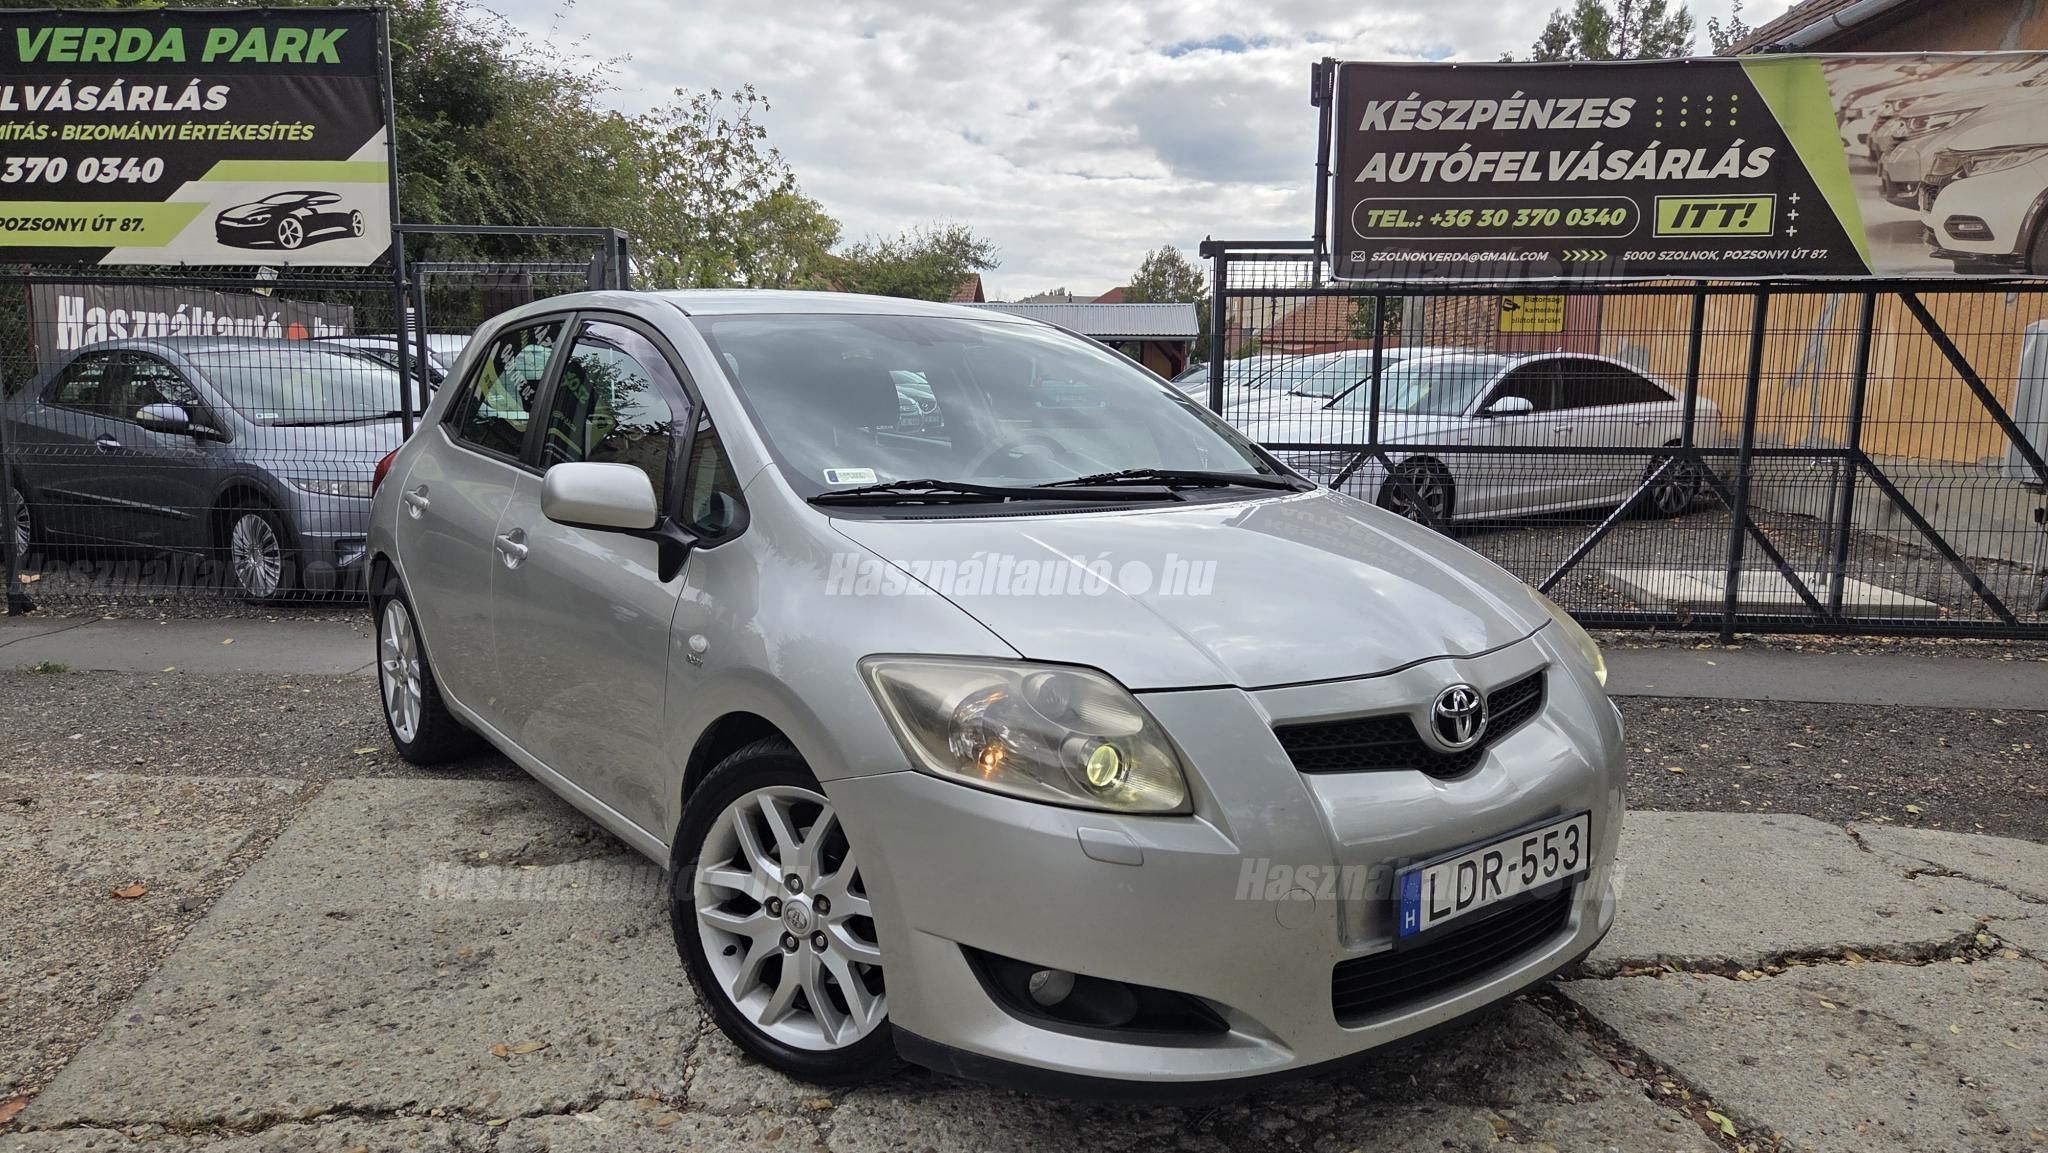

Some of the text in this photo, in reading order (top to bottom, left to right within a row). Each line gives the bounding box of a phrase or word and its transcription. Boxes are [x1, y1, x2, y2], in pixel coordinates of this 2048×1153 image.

[16, 27, 349, 64] VERDA PARK
[0, 78, 230, 111] LVÁSÁRLÁS
[1358, 90, 1636, 131] KÉSZPÉNZES
[61, 121, 176, 141] BIZOMÁNYI
[178, 120, 315, 141] ÉRTÉKESÍTÉS
[1, 157, 164, 184] 370 0340
[1354, 138, 1776, 183] AUTÓFELVÁSÁRLÁS
[92, 214, 116, 232] ÚT
[119, 217, 145, 232] 87.
[1367, 206, 1627, 228] TEL.: +36 30 370 0340
[1670, 202, 1756, 229] ITT!
[1371, 250, 1549, 263] SZOLNOKVERDA@GMAIL.COM
[1623, 245, 1828, 262] 5000 SZOLNOK, POZSONYI ÚT 87.
[1428, 824, 1580, 923] LDR-553
[1404, 910, 1416, 928] H
